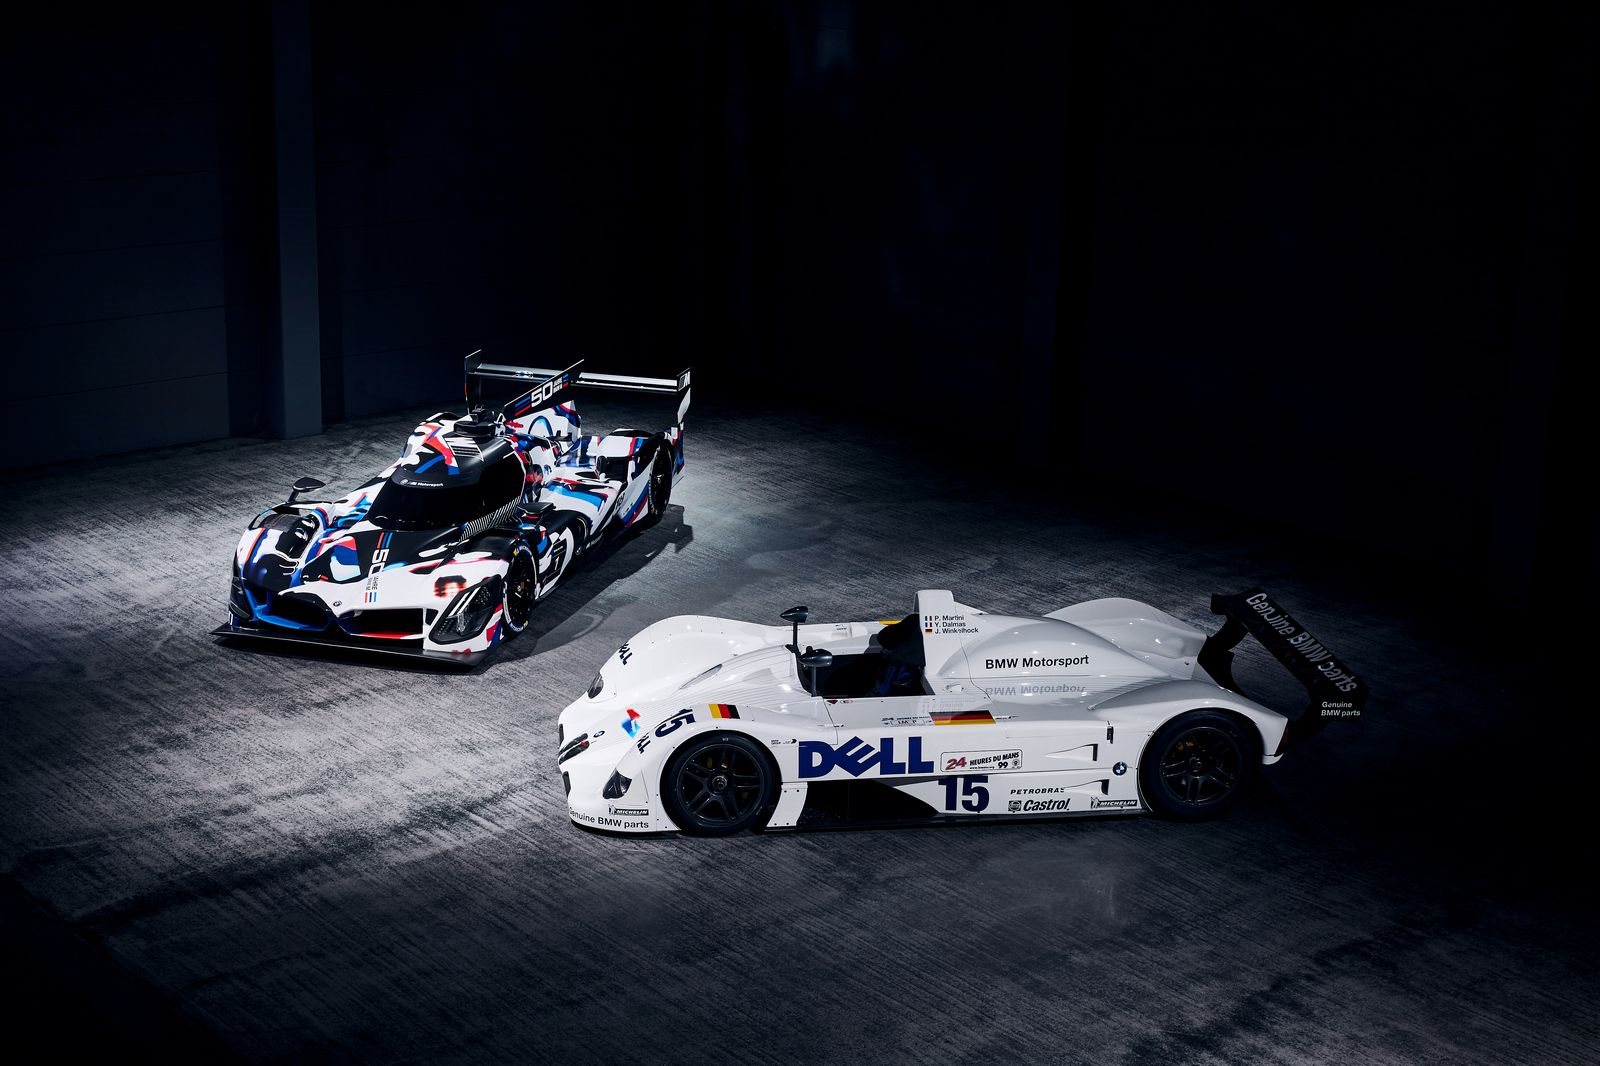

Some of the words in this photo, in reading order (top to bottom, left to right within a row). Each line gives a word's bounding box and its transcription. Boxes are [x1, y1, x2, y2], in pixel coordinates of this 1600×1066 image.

[531, 381, 553, 408] 50
[368, 549, 390, 578] 50
[1246, 592, 1295, 635] Genuine
[1287, 631, 1333, 662] BMW
[985, 658, 1019, 669] BMW
[1022, 655, 1089, 668] Motorsport
[798, 736, 934, 778] DELL
[945, 756, 967, 771] 24
[969, 756, 992, 767] HEURES
[1002, 751, 1020, 761] MANS
[997, 761, 1009, 769] 99
[938, 775, 990, 812] 15
[1023, 797, 1071, 812] Castrol
[598, 816, 622, 828] BMW
[624, 821, 649, 830] parts
